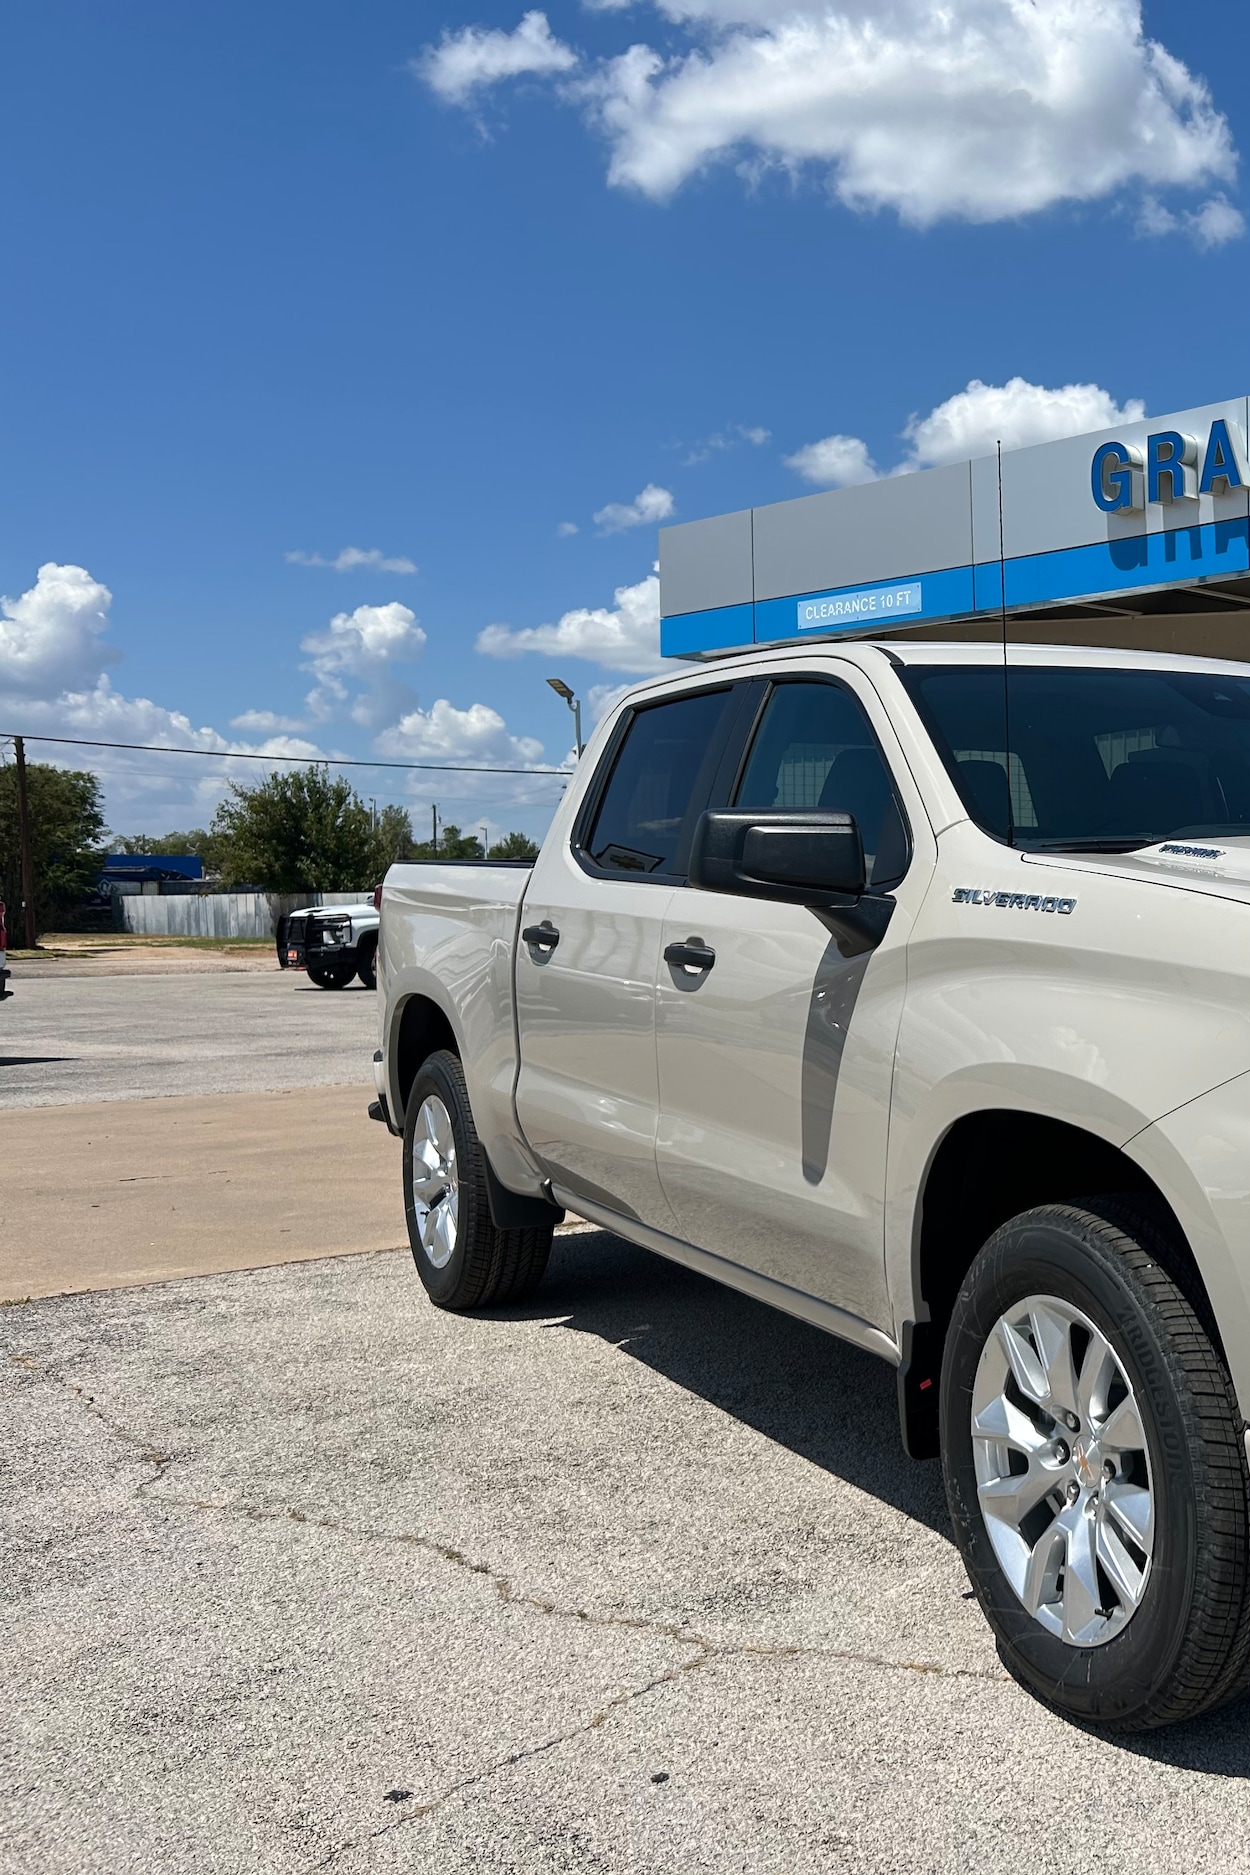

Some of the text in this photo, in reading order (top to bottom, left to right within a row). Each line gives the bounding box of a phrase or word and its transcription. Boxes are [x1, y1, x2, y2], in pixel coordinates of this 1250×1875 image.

[805, 590, 912, 620] CLEARANCE 10 FT
[951, 887, 1077, 914] SILVERADO
